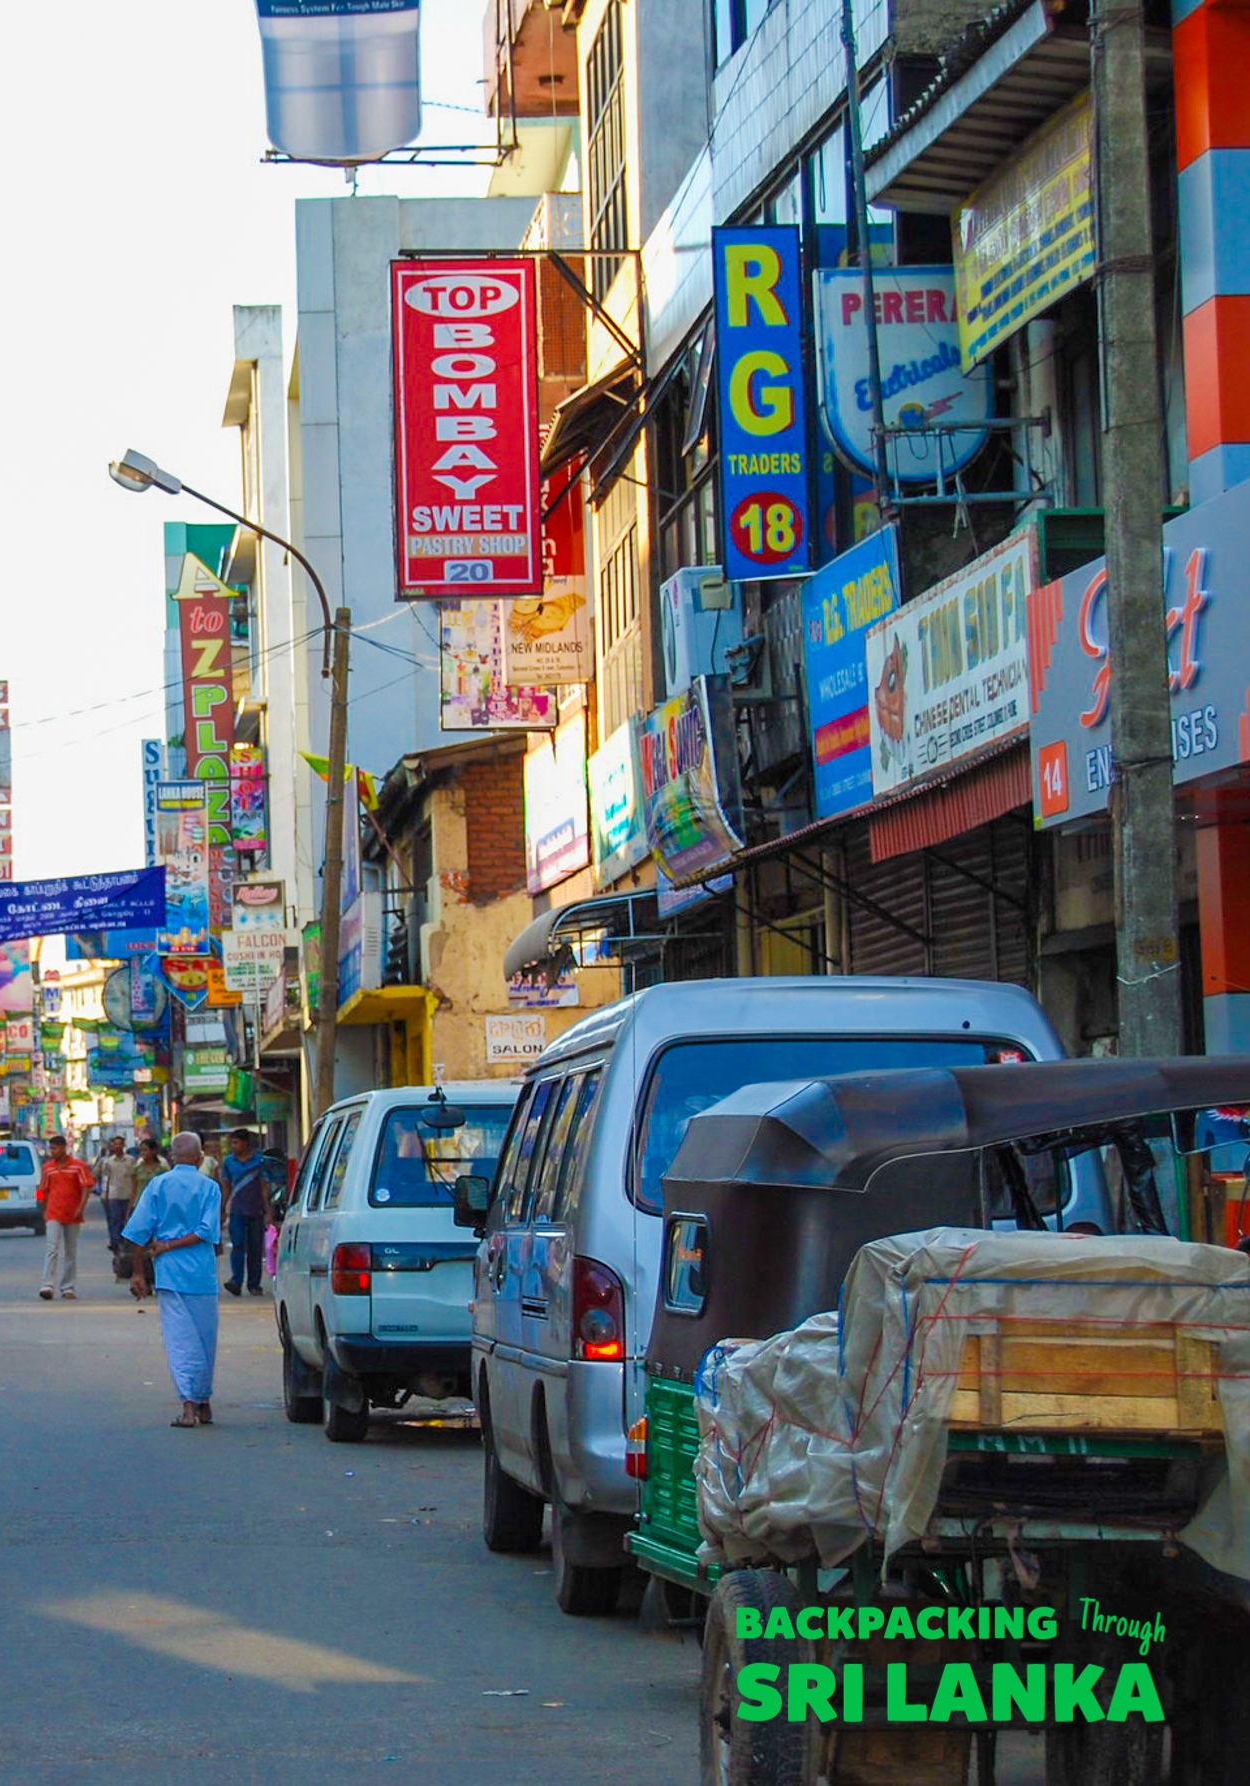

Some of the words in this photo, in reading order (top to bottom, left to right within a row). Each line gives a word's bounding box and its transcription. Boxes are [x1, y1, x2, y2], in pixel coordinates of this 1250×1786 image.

[300, 4, 330, 14] System
[331, 4, 344, 12] For
[347, 2, 370, 12] Tough
[372, 1, 390, 10] Male
[422, 285, 502, 311] TOP
[854, 340, 962, 412] Eectricals
[431, 322, 498, 500] BOMBAY
[728, 452, 801, 475] TRADERS
[411, 504, 524, 532] SWEET
[738, 502, 795, 554] 18
[410, 534, 474, 556] PASTRY
[478, 533, 527, 554] SHOP
[171, 551, 240, 600] A
[449, 563, 490, 582] 20
[842, 559, 893, 633] TRADERS
[189, 606, 225, 634] to
[190, 638, 226, 678] Z
[511, 642, 533, 654] NEW
[535, 641, 584, 654] MIDLANDS
[914, 699, 948, 739] CHINESE
[949, 683, 981, 726] DENTAL
[1086, 704, 1218, 793] ENISES
[1043, 757, 1062, 800] 14
[237, 933, 287, 948] FALCON
[493, 1043, 543, 1055] SALON
